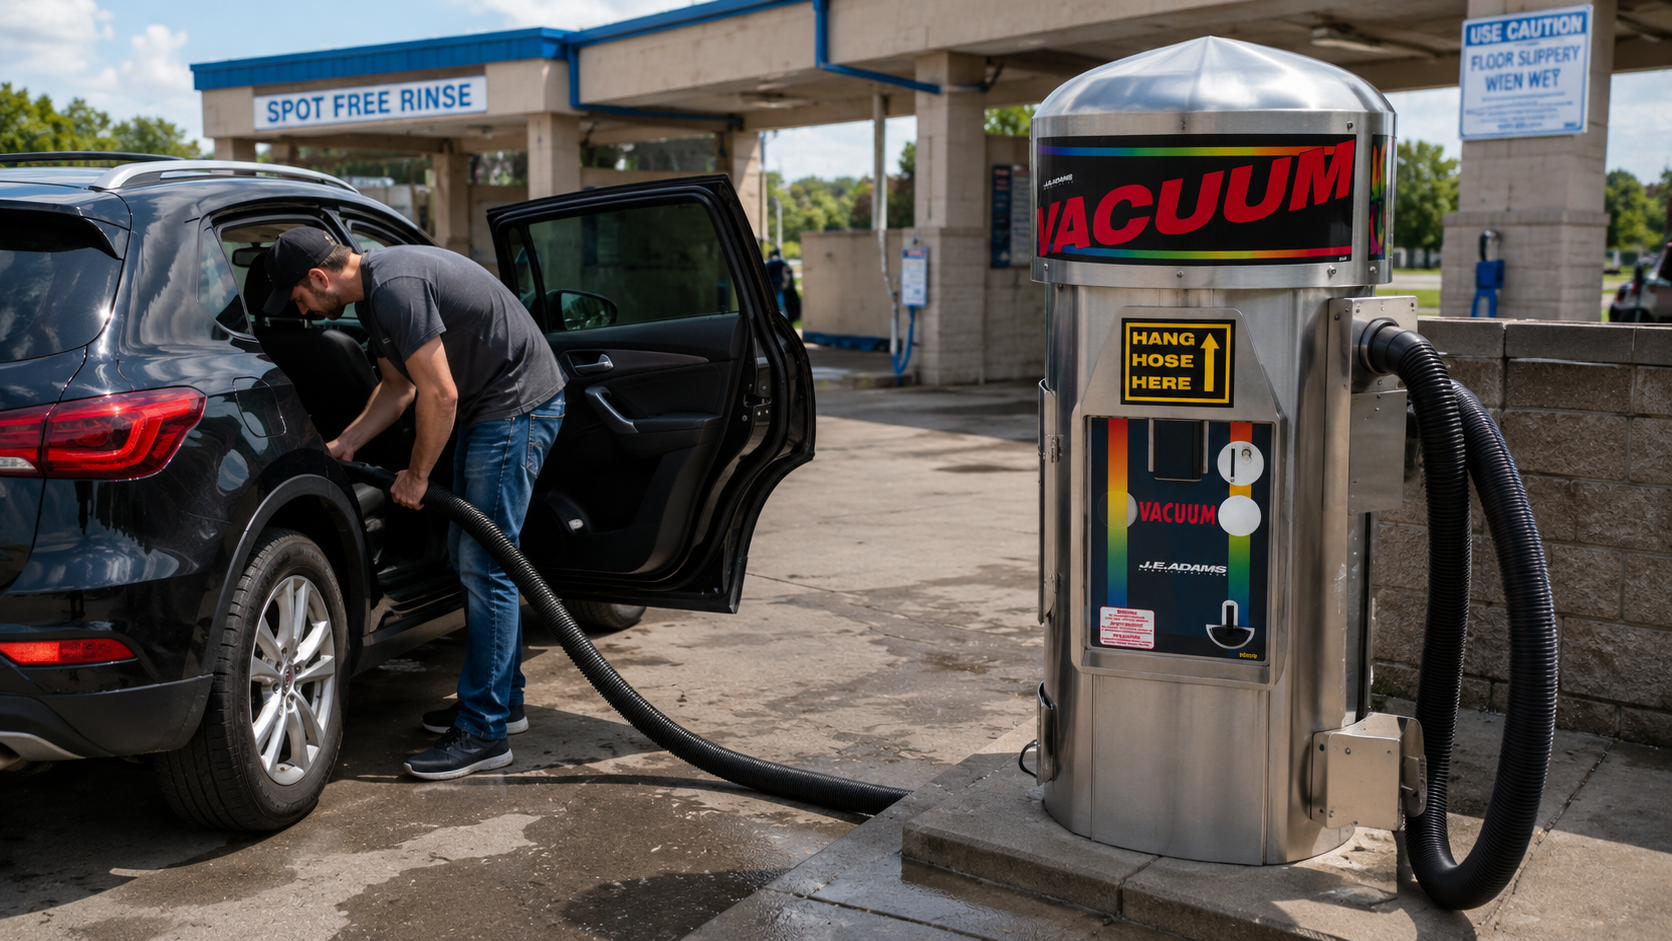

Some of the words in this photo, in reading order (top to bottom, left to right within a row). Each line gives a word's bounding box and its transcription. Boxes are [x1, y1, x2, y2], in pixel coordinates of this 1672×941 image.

[1470, 23, 1502, 44] USE
[1507, 14, 1583, 40] CAUTION
[1471, 51, 1514, 71] FLOOR
[1518, 45, 1580, 67] SLIPPERY
[267, 96, 324, 123] SPOT
[333, 91, 391, 117] FREE
[401, 83, 472, 112] RINSE
[1037, 139, 1356, 257] VACUUM
[1132, 331, 1195, 346] HANG
[1132, 353, 1194, 368] HOSE
[1132, 375, 1191, 390] HERE
[1139, 501, 1216, 525] VACUUM
